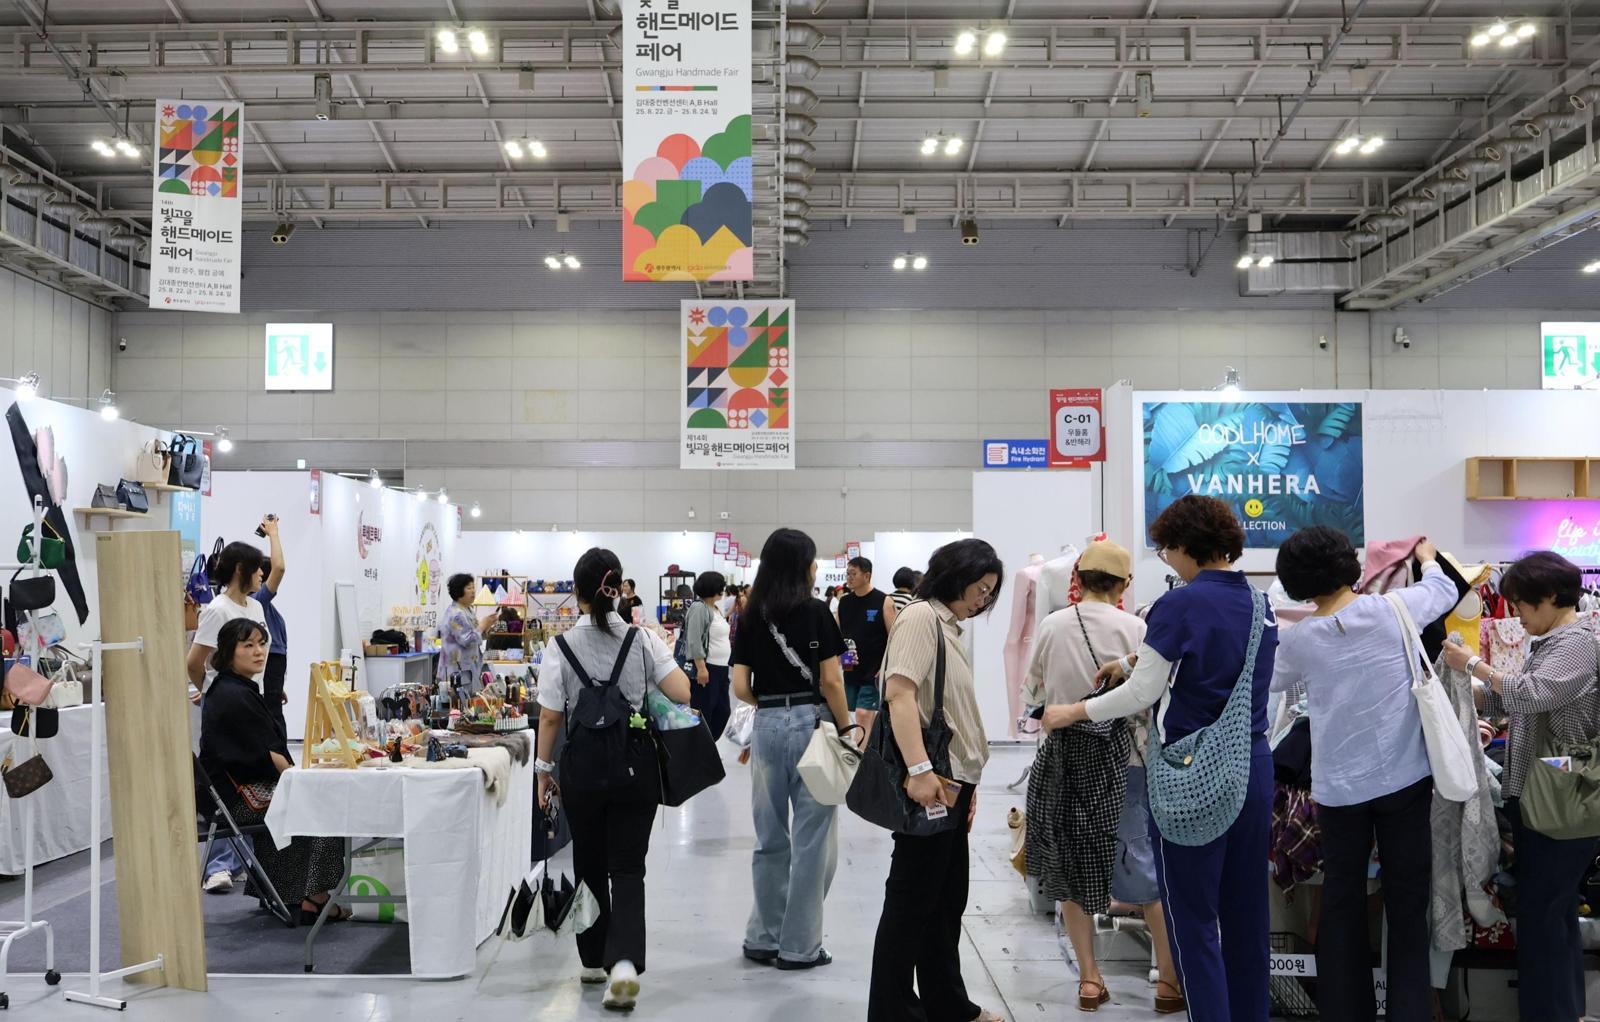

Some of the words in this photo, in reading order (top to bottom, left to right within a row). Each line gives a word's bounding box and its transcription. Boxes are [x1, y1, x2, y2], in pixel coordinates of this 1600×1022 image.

[636, 12, 739, 39] 핸드메이드
[636, 43, 681, 62] 페어
[635, 67, 673, 78] Gwangju
[676, 67, 721, 77] Handmade
[724, 67, 739, 77] Fair
[161, 208, 193, 226] 빛고을
[160, 226, 233, 244] 핸드메이드
[160, 246, 193, 261] 페어
[1064, 414, 1091, 423] C-01
[1199, 421, 1307, 445] OODLHOME
[686, 443, 710, 456] 빛고을
[711, 443, 790, 457] 핸드메이드페어
[1010, 447, 1046, 456] 옥내소화전
[1187, 474, 1321, 495] VANHERA
